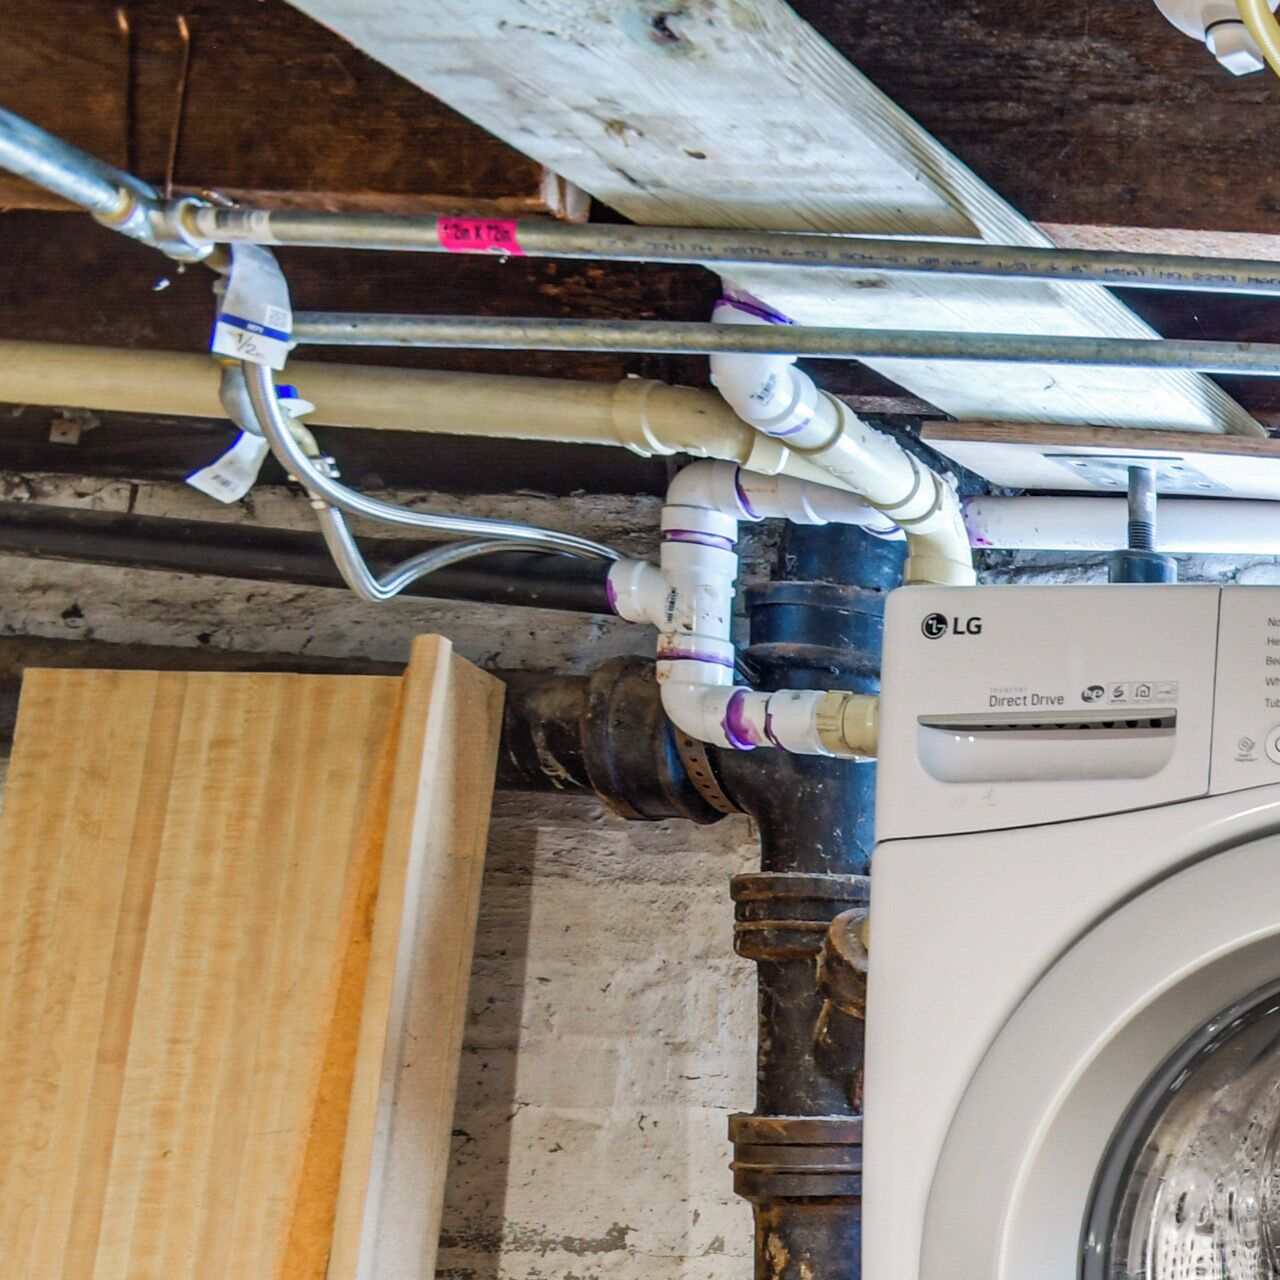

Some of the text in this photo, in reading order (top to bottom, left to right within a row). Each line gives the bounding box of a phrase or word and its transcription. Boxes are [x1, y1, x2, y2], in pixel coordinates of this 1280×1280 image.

[952, 616, 983, 635] LG
[988, 693, 1065, 707] Direct Drive
